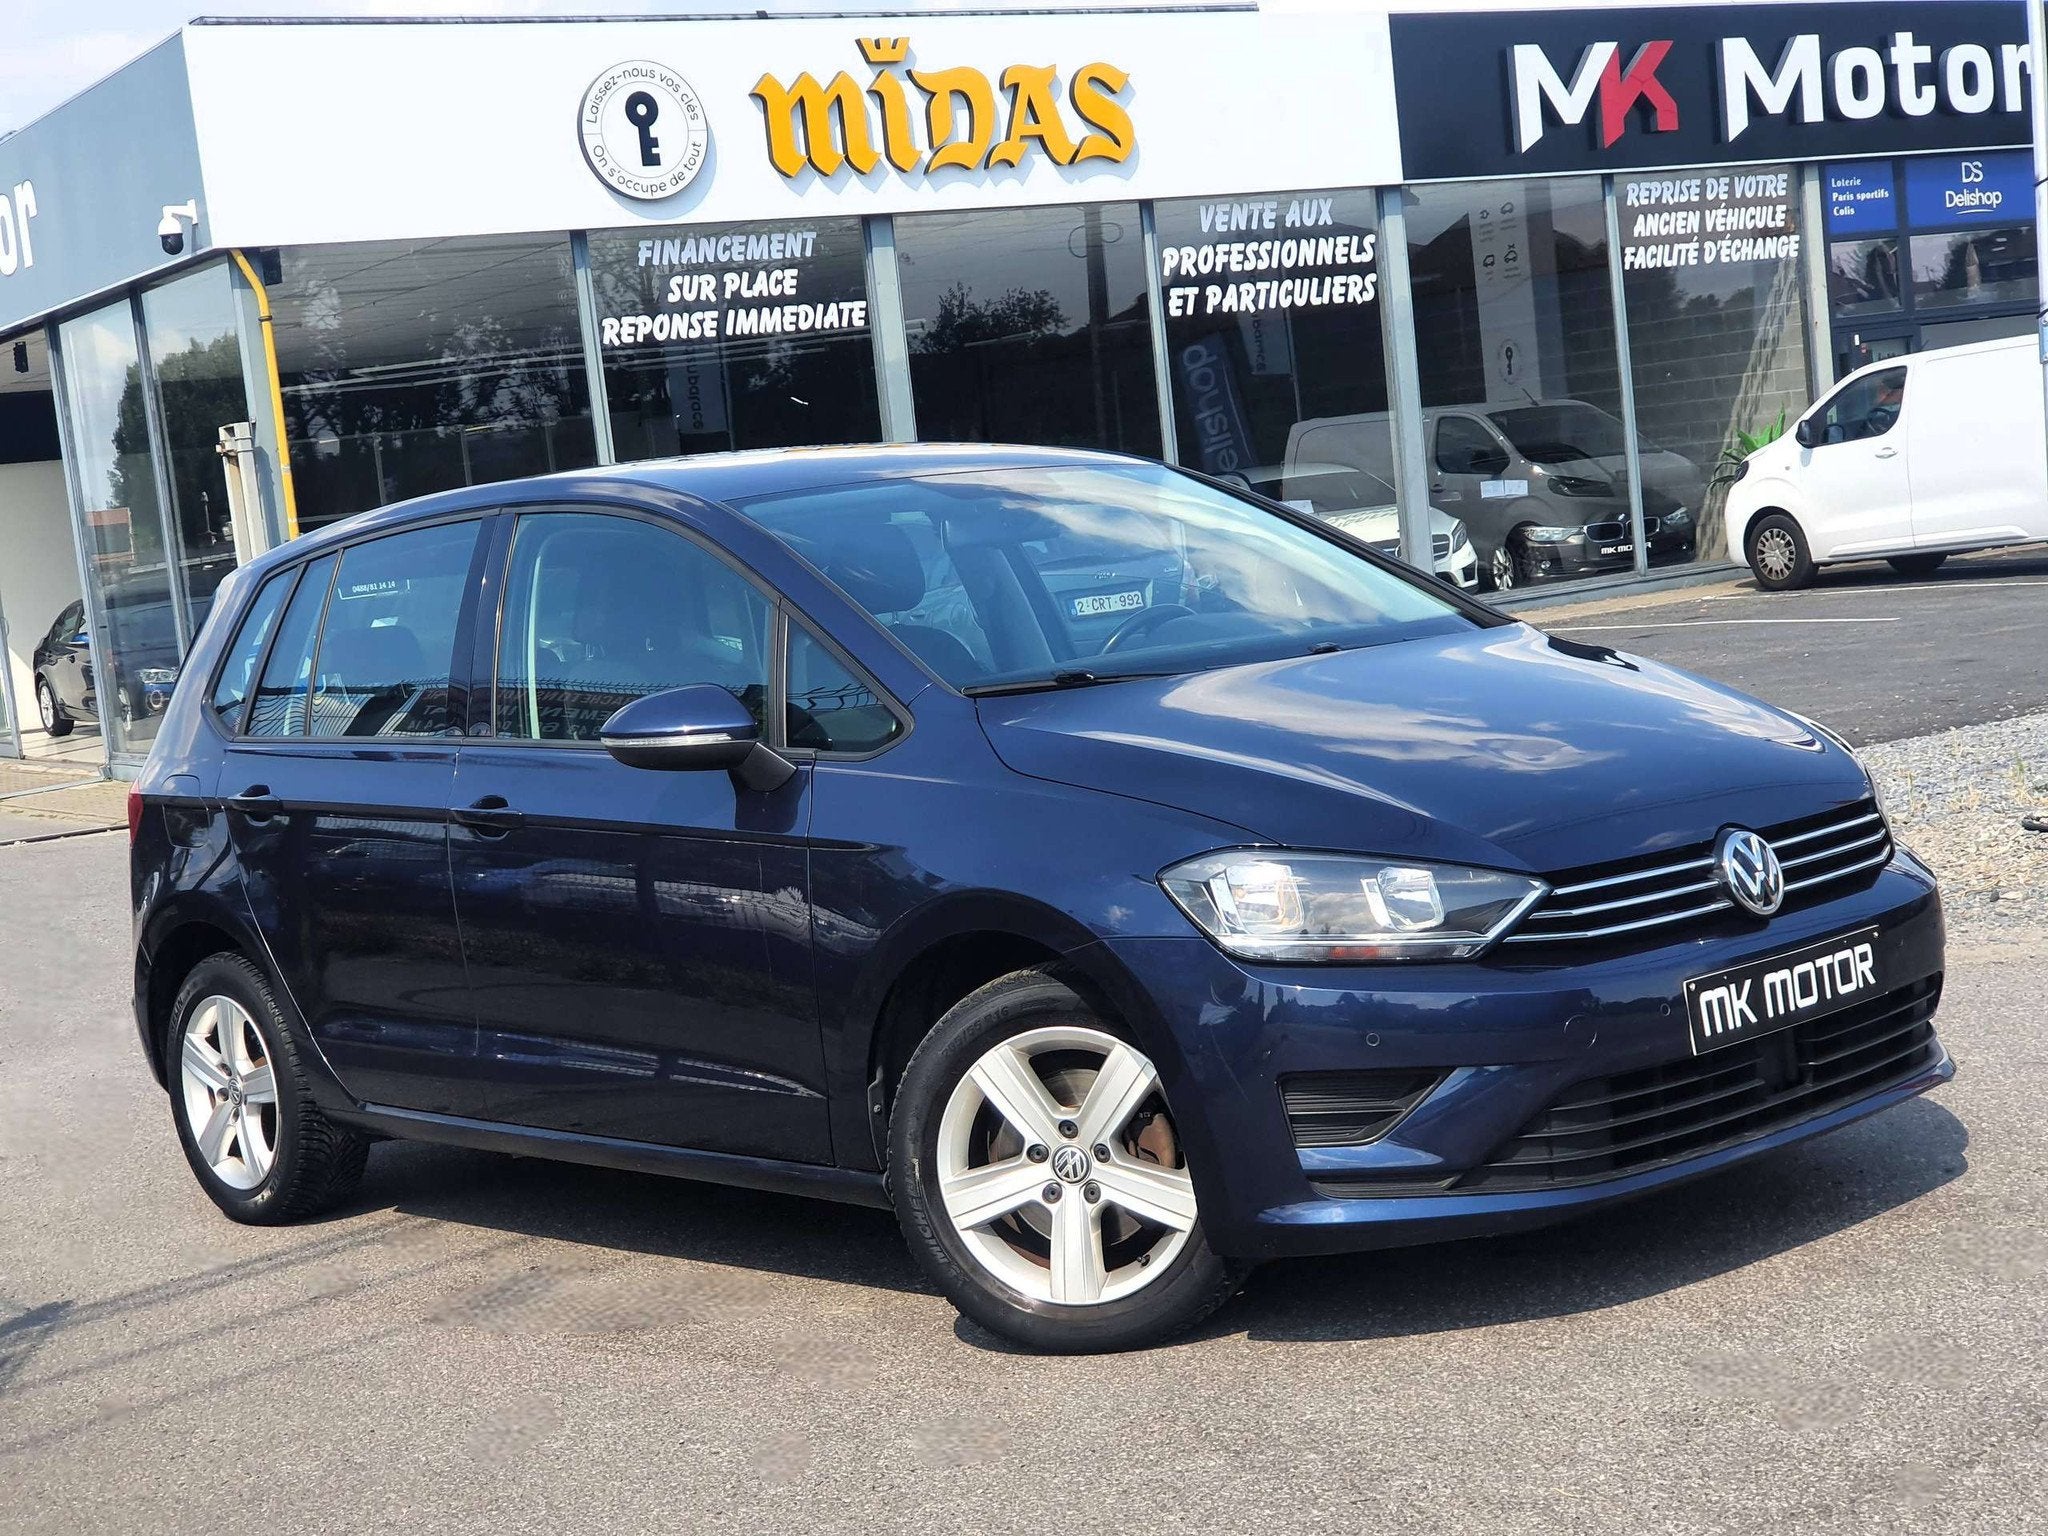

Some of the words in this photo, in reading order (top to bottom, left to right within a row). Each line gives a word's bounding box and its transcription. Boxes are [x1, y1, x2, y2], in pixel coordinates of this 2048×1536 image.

[586, 67, 656, 124] Laissez-nous
[659, 73, 681, 93] vos
[681, 91, 699, 121] clés
[1507, 40, 1679, 154] MK
[1714, 31, 2032, 144] Motor
[593, 145, 609, 168] On
[608, 167, 667, 197] s'occupe
[669, 171, 686, 187] de
[684, 141, 701, 171] tout
[1831, 177, 1862, 188] Loterie
[1961, 160, 1984, 183] DS
[1626, 179, 1701, 208] REPRISE
[1706, 177, 1730, 201] DE
[1734, 173, 1788, 199] VOTRE
[1832, 191, 1854, 202] Paris
[1856, 188, 1889, 201] sportifs
[1945, 188, 2003, 209] Delishop
[1200, 201, 1278, 233] VENTE
[1285, 198, 1334, 228] AUX
[1633, 210, 1700, 238] ANCIEN
[1704, 202, 1787, 232] VÉHICULE
[1833, 206, 1855, 217] Colis
[637, 231, 817, 267] FINANCEMENT
[1162, 234, 1376, 277] PROFESSIONNELS
[1624, 236, 1700, 270] FACILITÉ
[1703, 233, 1800, 264] D'ÉCHANGE
[667, 273, 717, 303] SUR
[723, 268, 799, 300] PLACE
[1168, 287, 1199, 317] ET
[1205, 273, 1378, 314] PARTICULIERS
[601, 310, 719, 347] REPONSE
[725, 300, 867, 336] IMMEDIATE
[1182, 344, 1239, 472] elishop
[1699, 978, 1758, 1037] MK
[1763, 942, 1877, 1019] MOTOR
